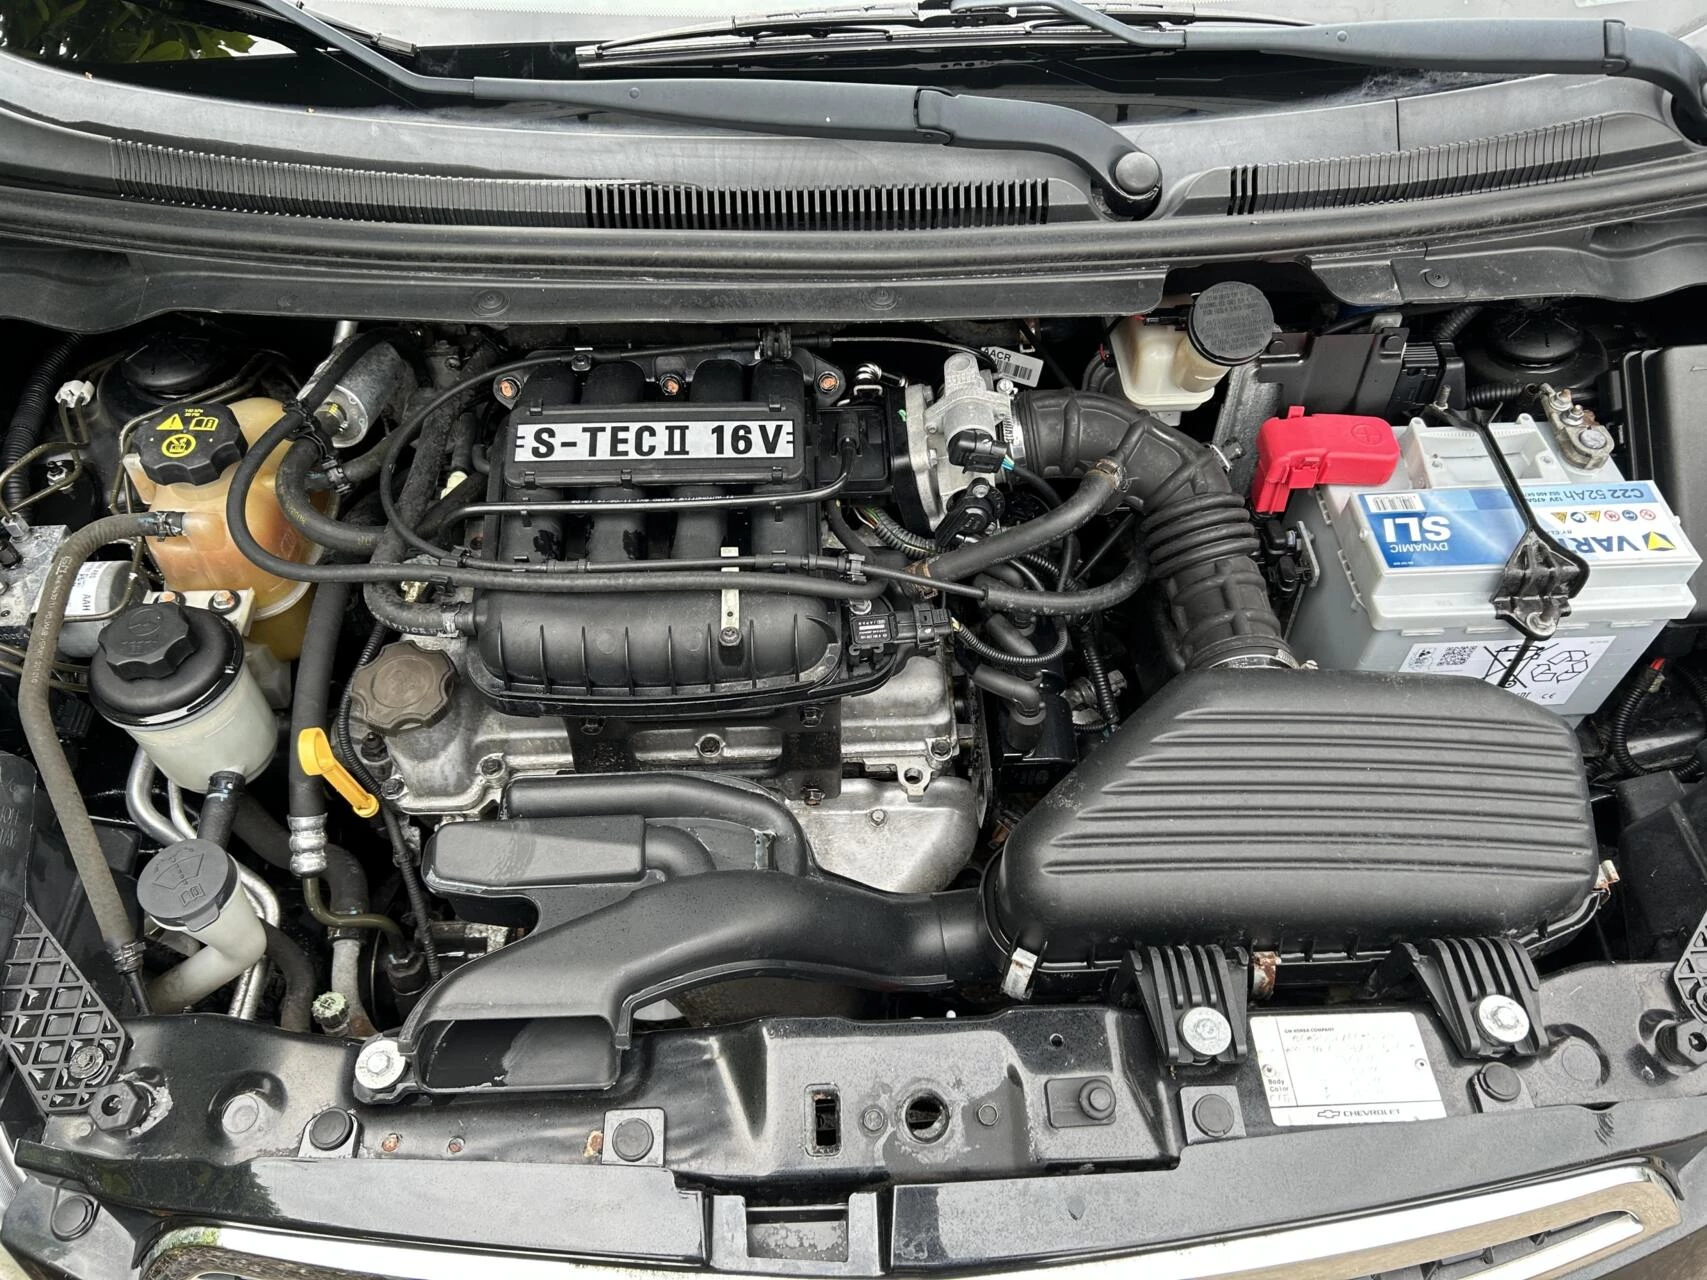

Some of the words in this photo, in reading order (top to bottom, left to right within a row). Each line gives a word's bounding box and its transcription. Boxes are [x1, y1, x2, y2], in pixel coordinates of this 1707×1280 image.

[711, 424, 783, 455] 16V
[1562, 489, 1607, 501] 52Ah
[1608, 488, 1644, 499] C22
[1383, 515, 1451, 543] SLI
[1389, 542, 1449, 553] DYNAMIC
[1343, 1109, 1400, 1117] CHEVROLET
